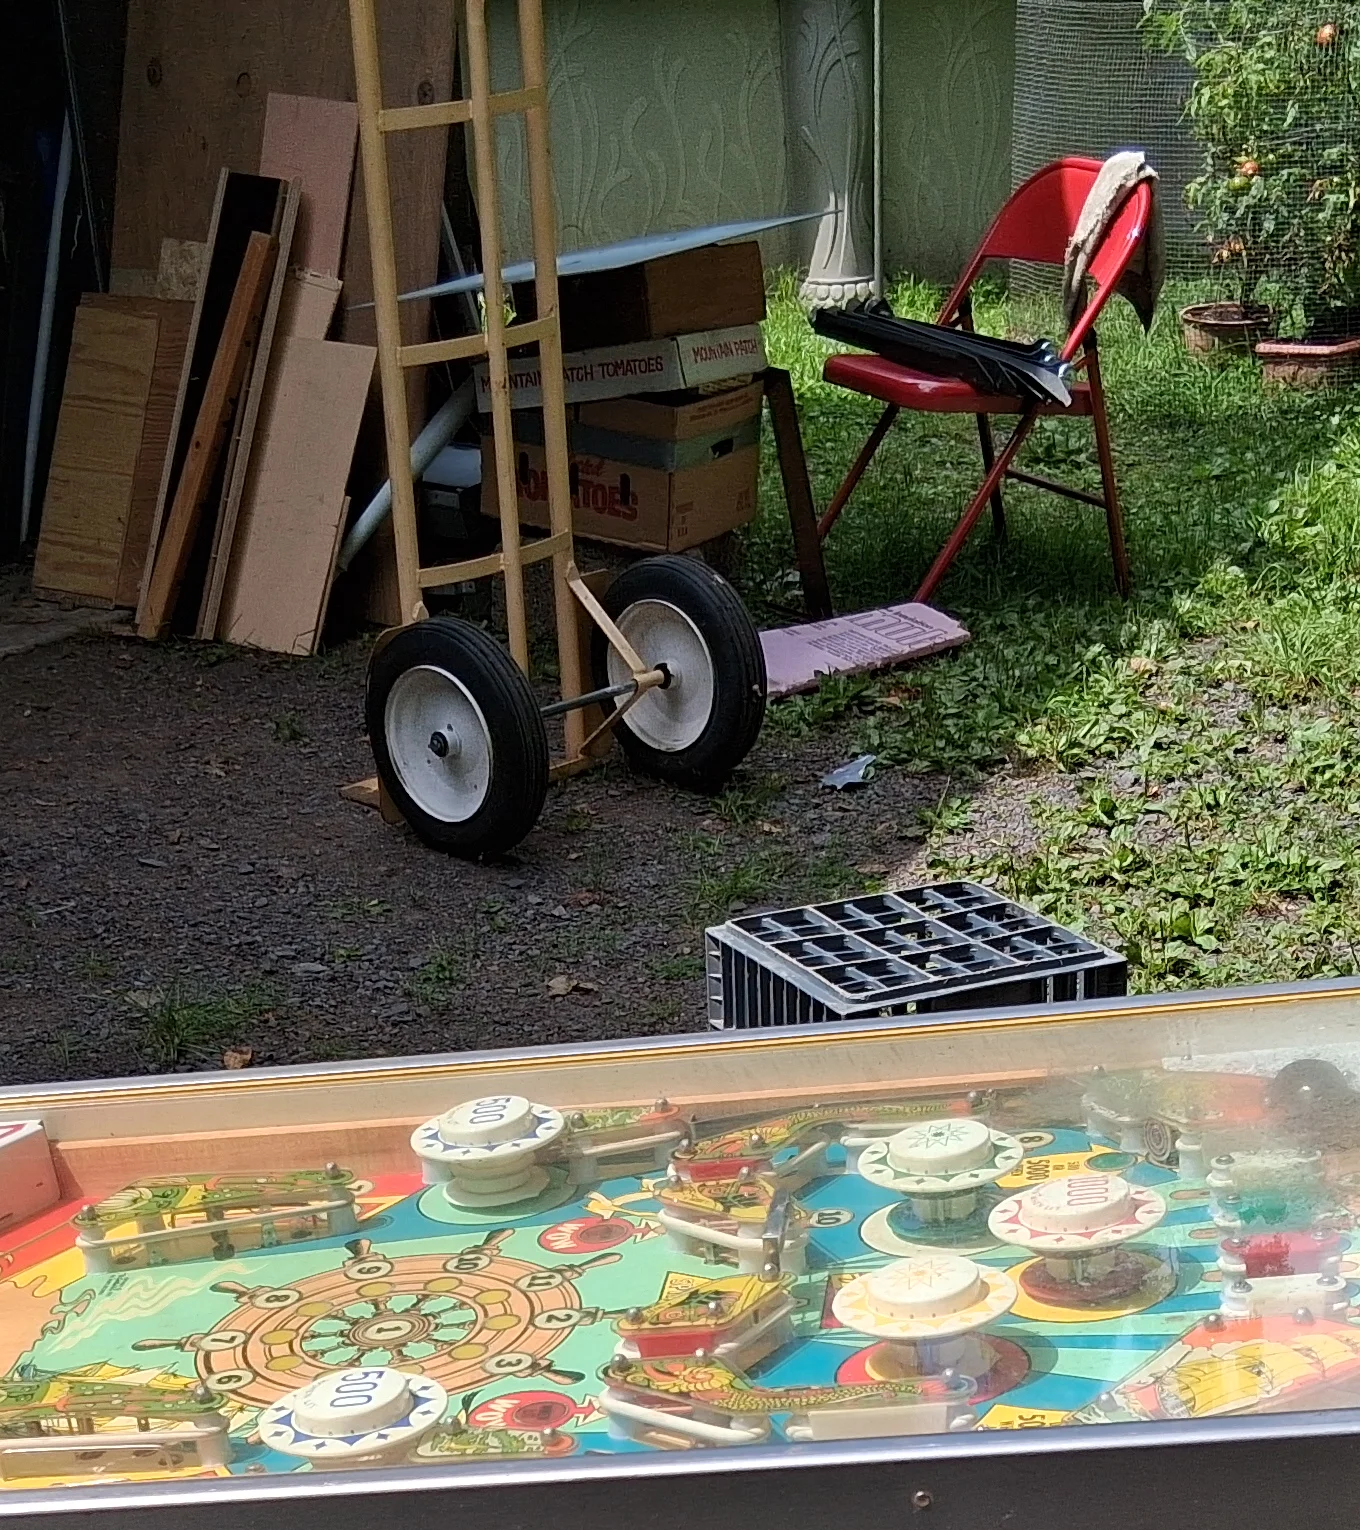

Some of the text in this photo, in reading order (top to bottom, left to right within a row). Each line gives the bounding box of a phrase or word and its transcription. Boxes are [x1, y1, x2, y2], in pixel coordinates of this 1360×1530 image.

[692, 338, 758, 364] MOUNTAIN PATCH
[481, 356, 664, 393] MNTAIN ATCH TOMATOES
[469, 1097, 512, 1125] 500
[817, 1211, 843, 1225] 10
[546, 1223, 586, 1250] WOW
[356, 1265, 382, 1276] 9
[454, 1255, 482, 1271] 10
[526, 1273, 558, 1289] 11
[264, 1294, 291, 1304] 8
[545, 1312, 573, 1324] 2
[210, 1335, 238, 1345] 7
[494, 1358, 523, 1369] 3
[216, 1374, 243, 1385] 6
[330, 1370, 385, 1408] 500
